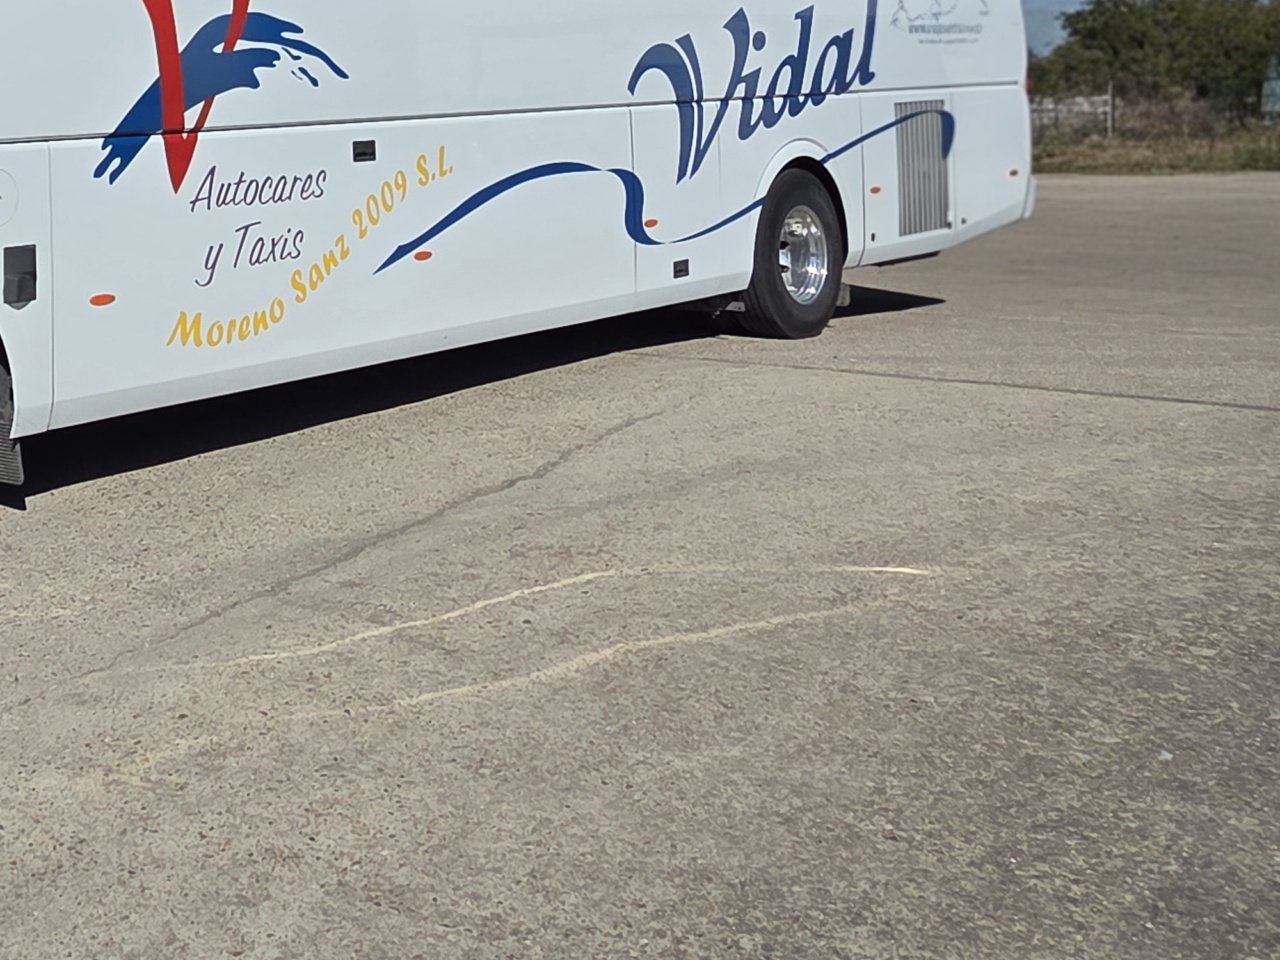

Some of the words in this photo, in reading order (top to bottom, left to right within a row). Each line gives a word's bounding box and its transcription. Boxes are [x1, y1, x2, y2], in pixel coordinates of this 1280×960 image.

[190, 165, 327, 212] Autocares
[166, 297, 285, 348] Moreno
[290, 234, 351, 304] Sanz
[352, 170, 408, 240] 2009
[415, 145, 455, 187] S.L.
[194, 242, 224, 287] y
[232, 221, 305, 269] Taxis
